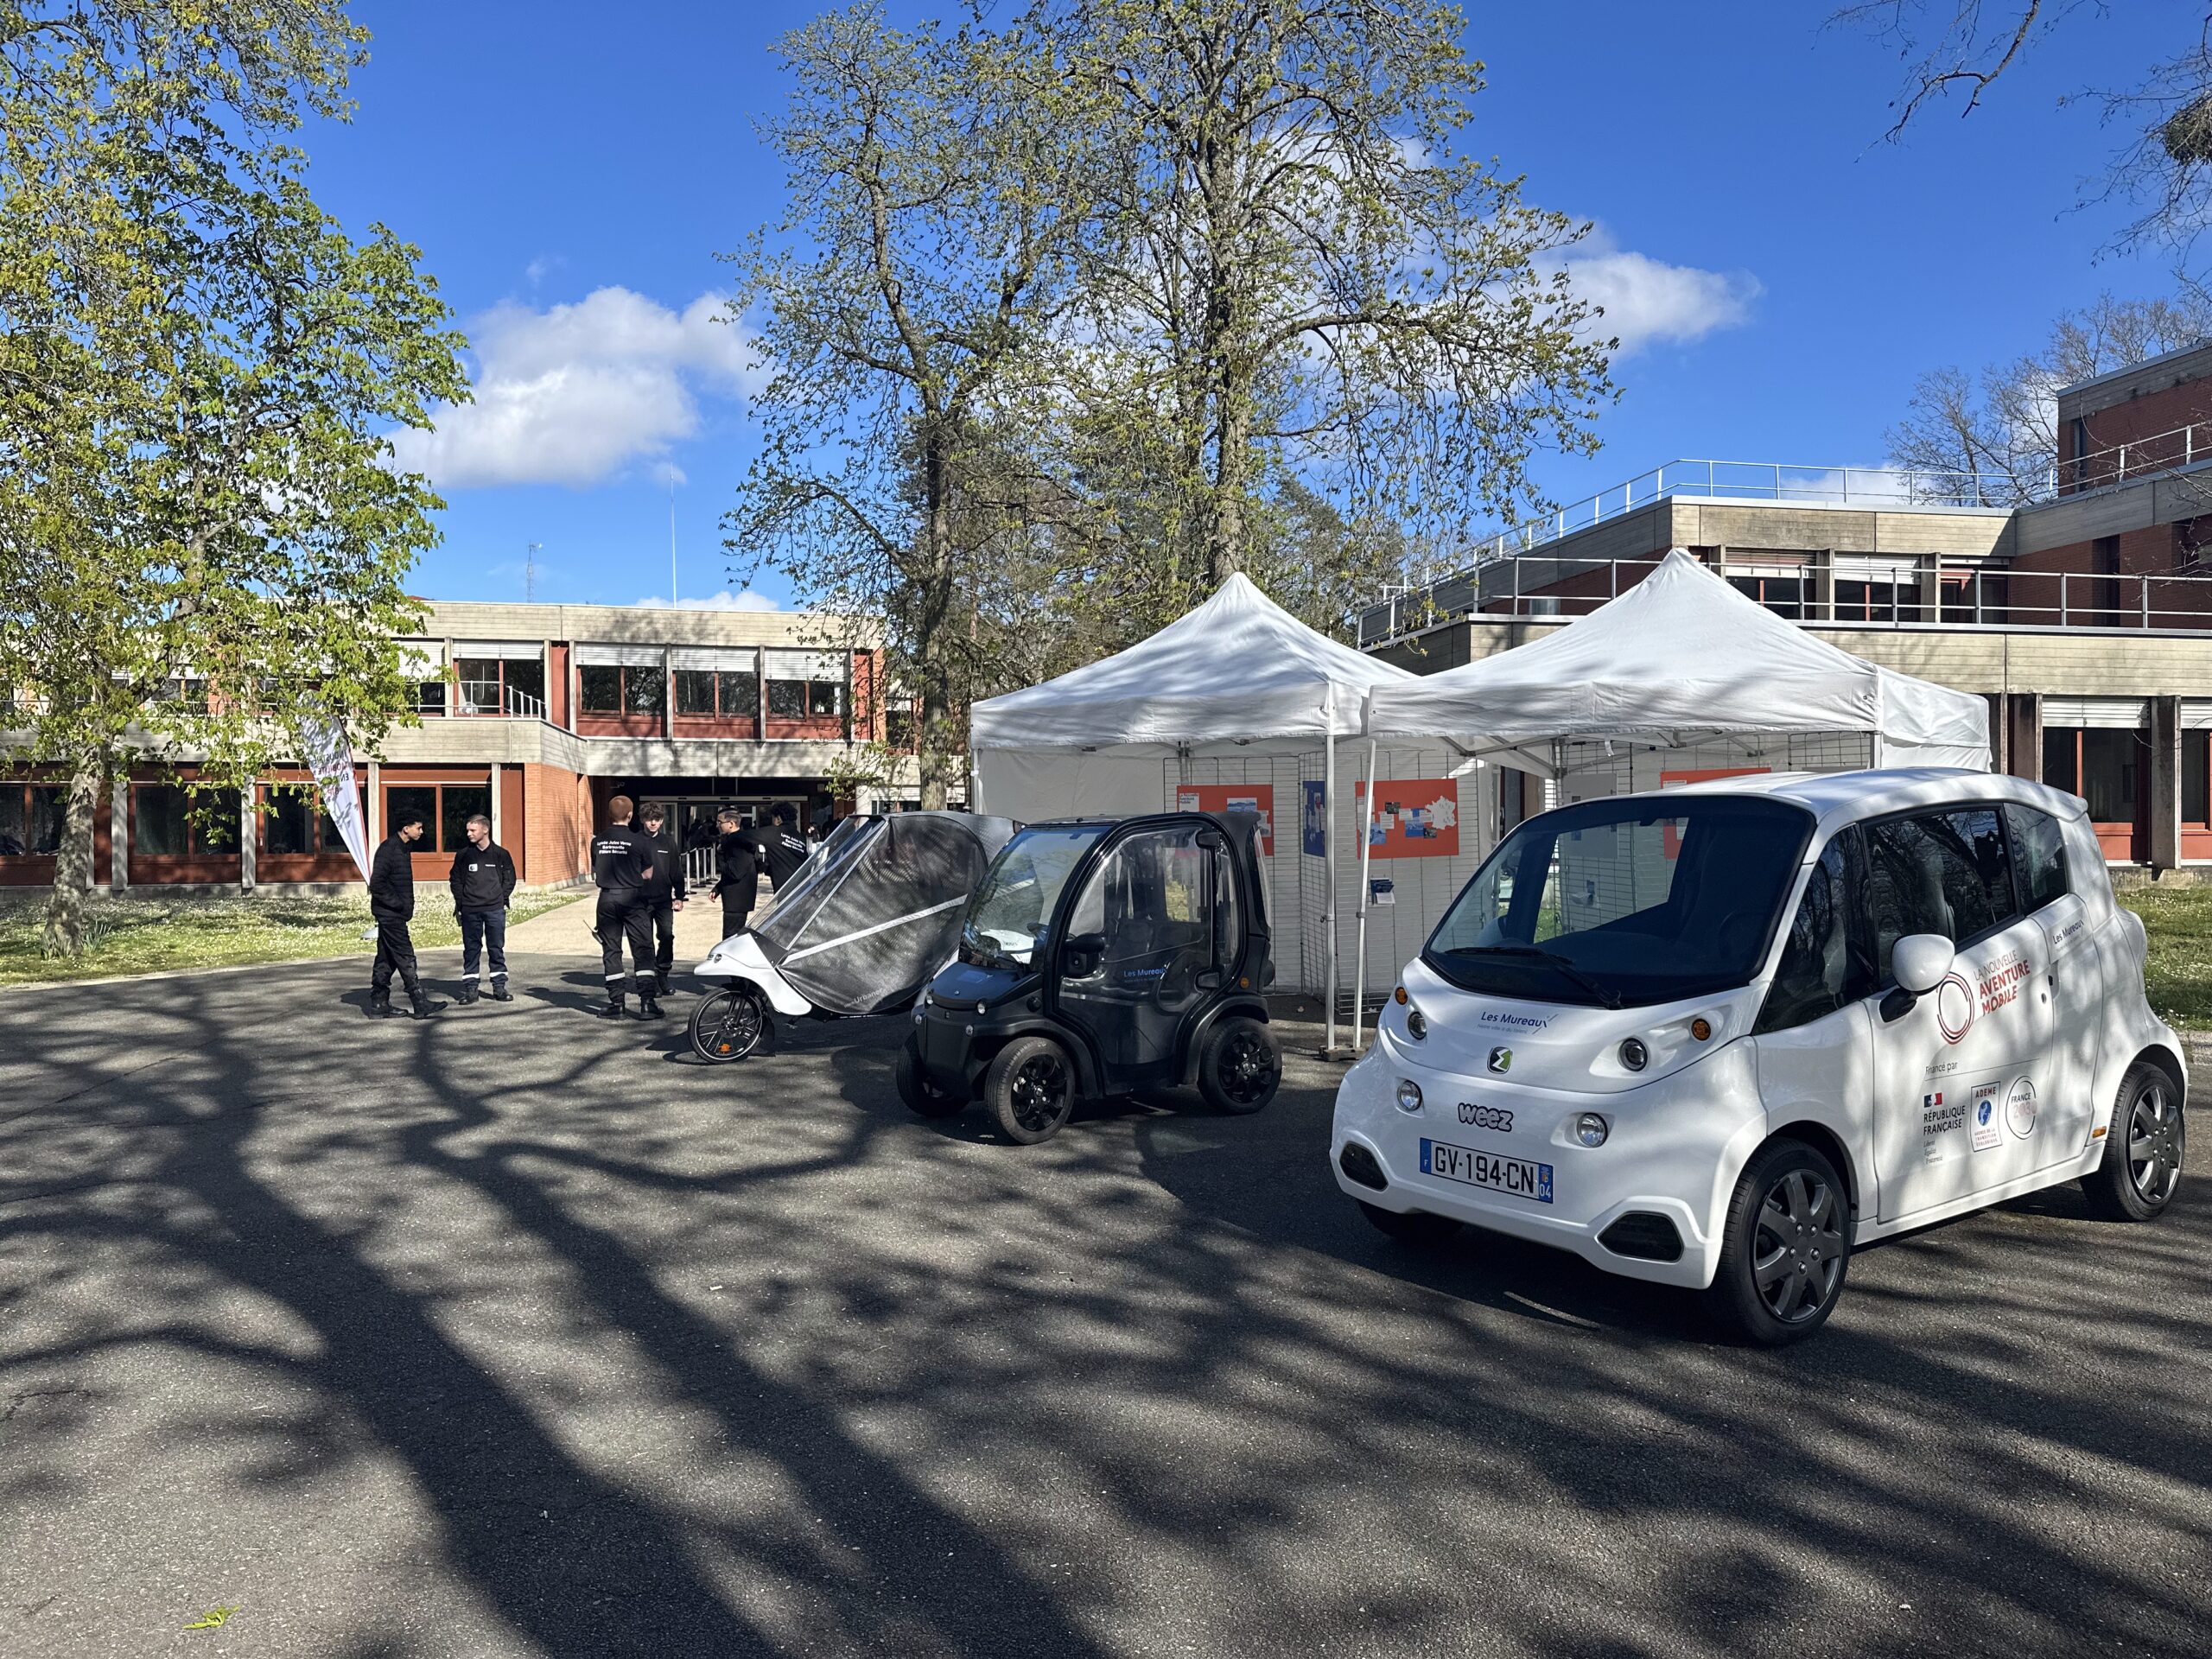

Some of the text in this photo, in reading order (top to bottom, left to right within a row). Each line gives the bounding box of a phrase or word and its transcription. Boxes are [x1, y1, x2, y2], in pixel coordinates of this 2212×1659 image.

[2052, 933, 2063, 944] Les
[1974, 950, 2018, 981] LA NOUVELLE
[1979, 959, 2031, 1000] AVENTURE
[1981, 985, 2018, 1017] MOBILE
[1481, 1011, 1498, 1022] Les
[1925, 1061, 1958, 1075] Financé par
[1975, 1086, 1997, 1098] ADEME
[2011, 1092, 2031, 1104] FRANCE
[1458, 1103, 1513, 1132] weez
[1923, 1105, 1966, 1123] RÉPUBLIQUE
[1923, 1119, 1962, 1136] FRANÇAISE
[1434, 1146, 1534, 1194] GV-194-CN
[1539, 1183, 1552, 1198] 04
